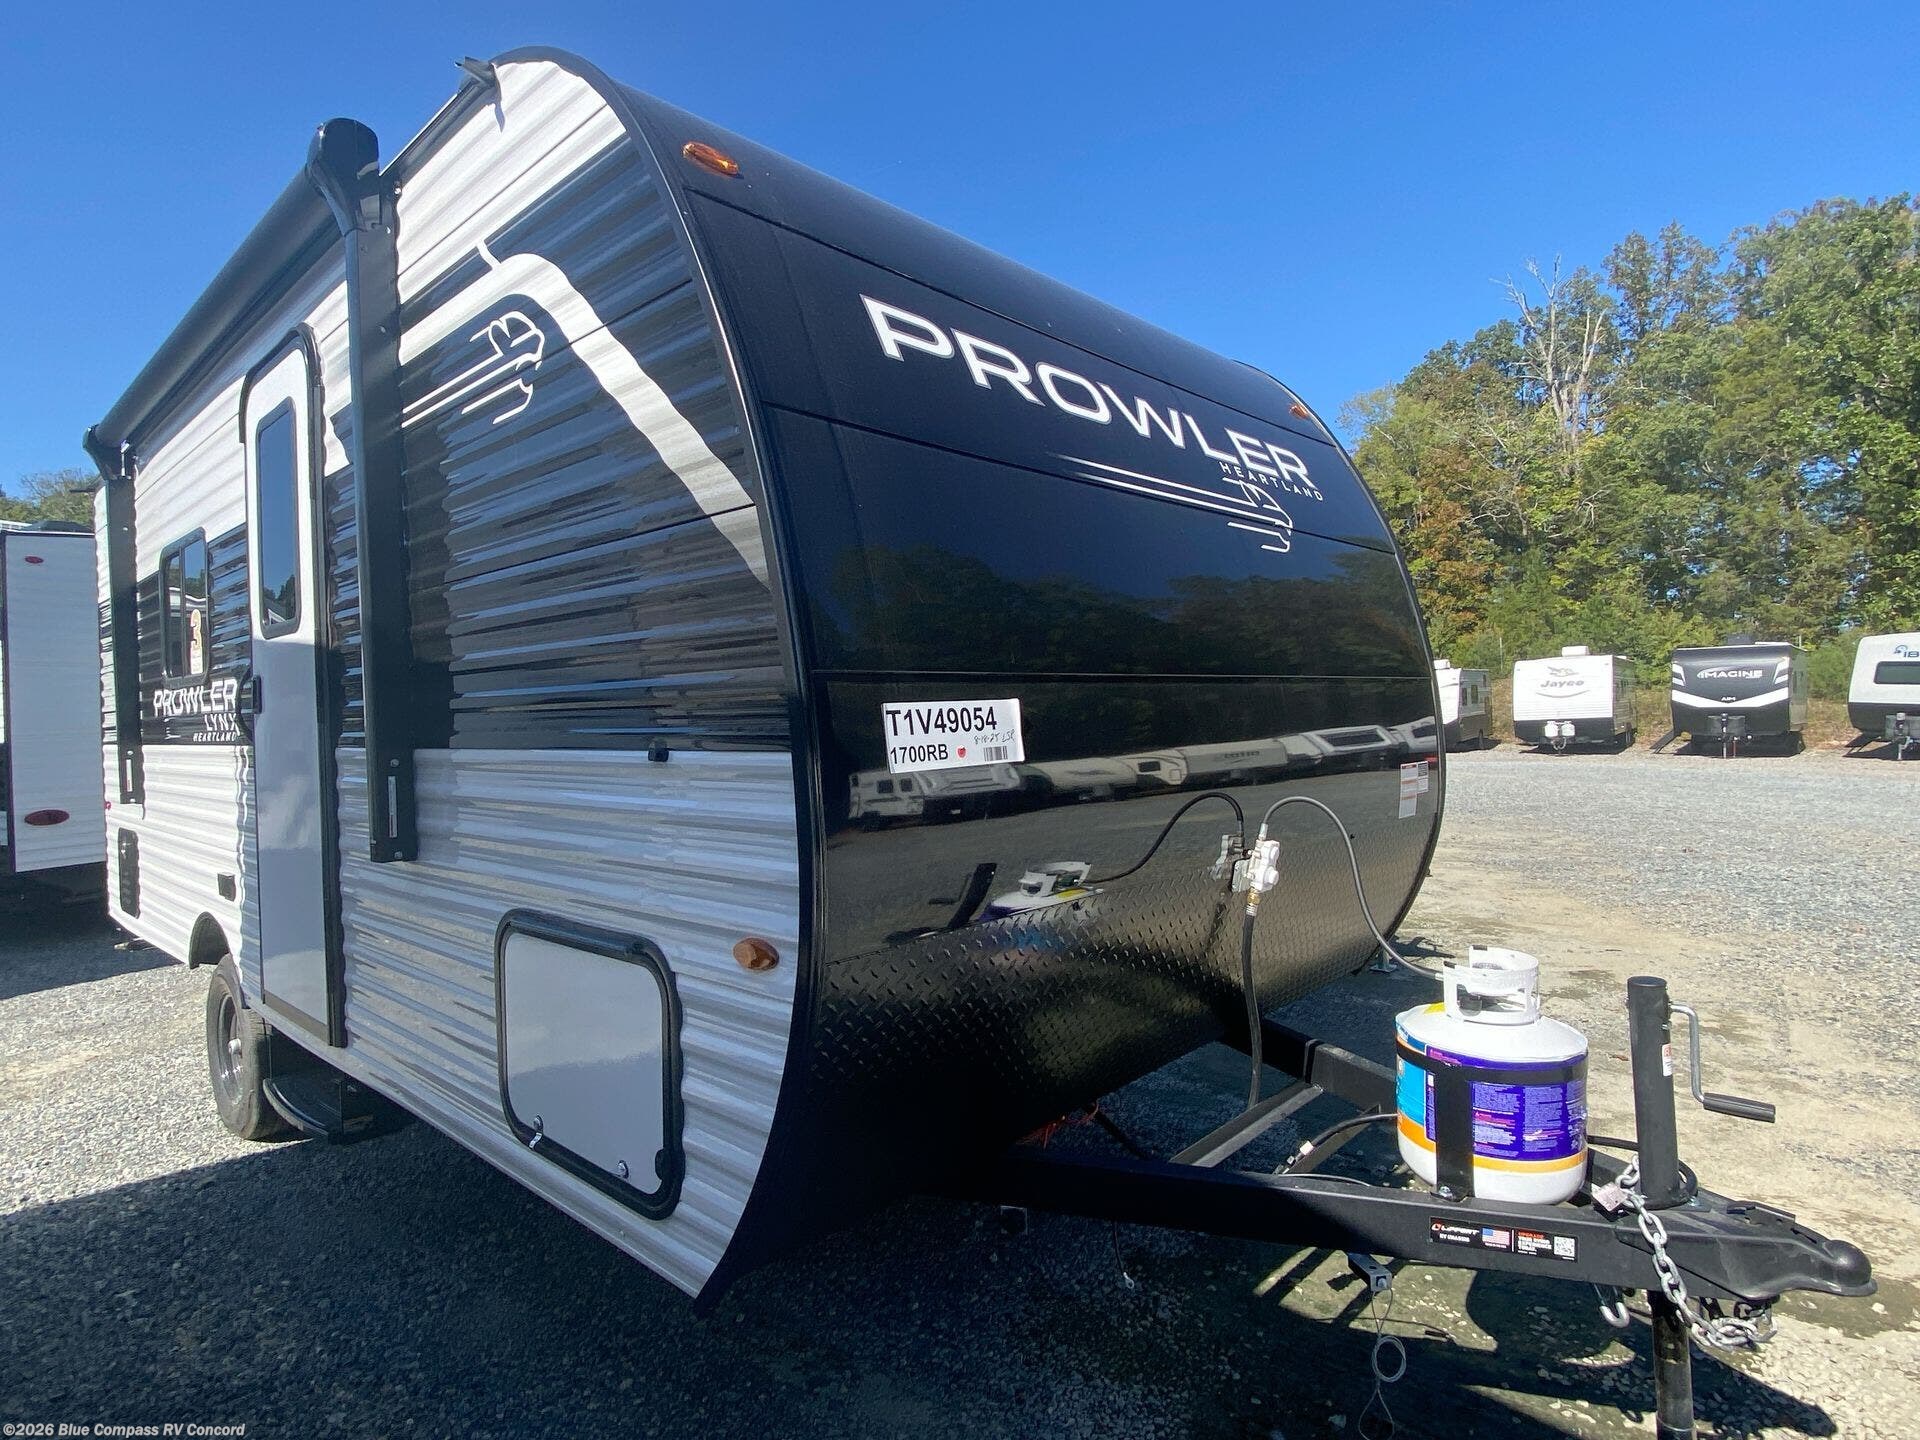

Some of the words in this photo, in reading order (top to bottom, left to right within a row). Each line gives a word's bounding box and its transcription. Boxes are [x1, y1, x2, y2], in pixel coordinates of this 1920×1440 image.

[859, 294, 1318, 490] PROWLER
[1219, 461, 1323, 501] HEARTLAND
[1540, 680, 1585, 688] Jayco
[1698, 669, 1763, 679] IMAGINE
[153, 679, 238, 718] PROWLER
[204, 713, 240, 736] LYNX
[886, 706, 998, 736] T1V49054
[193, 732, 236, 742] HEARTLAND
[890, 744, 949, 765] 1700RB
